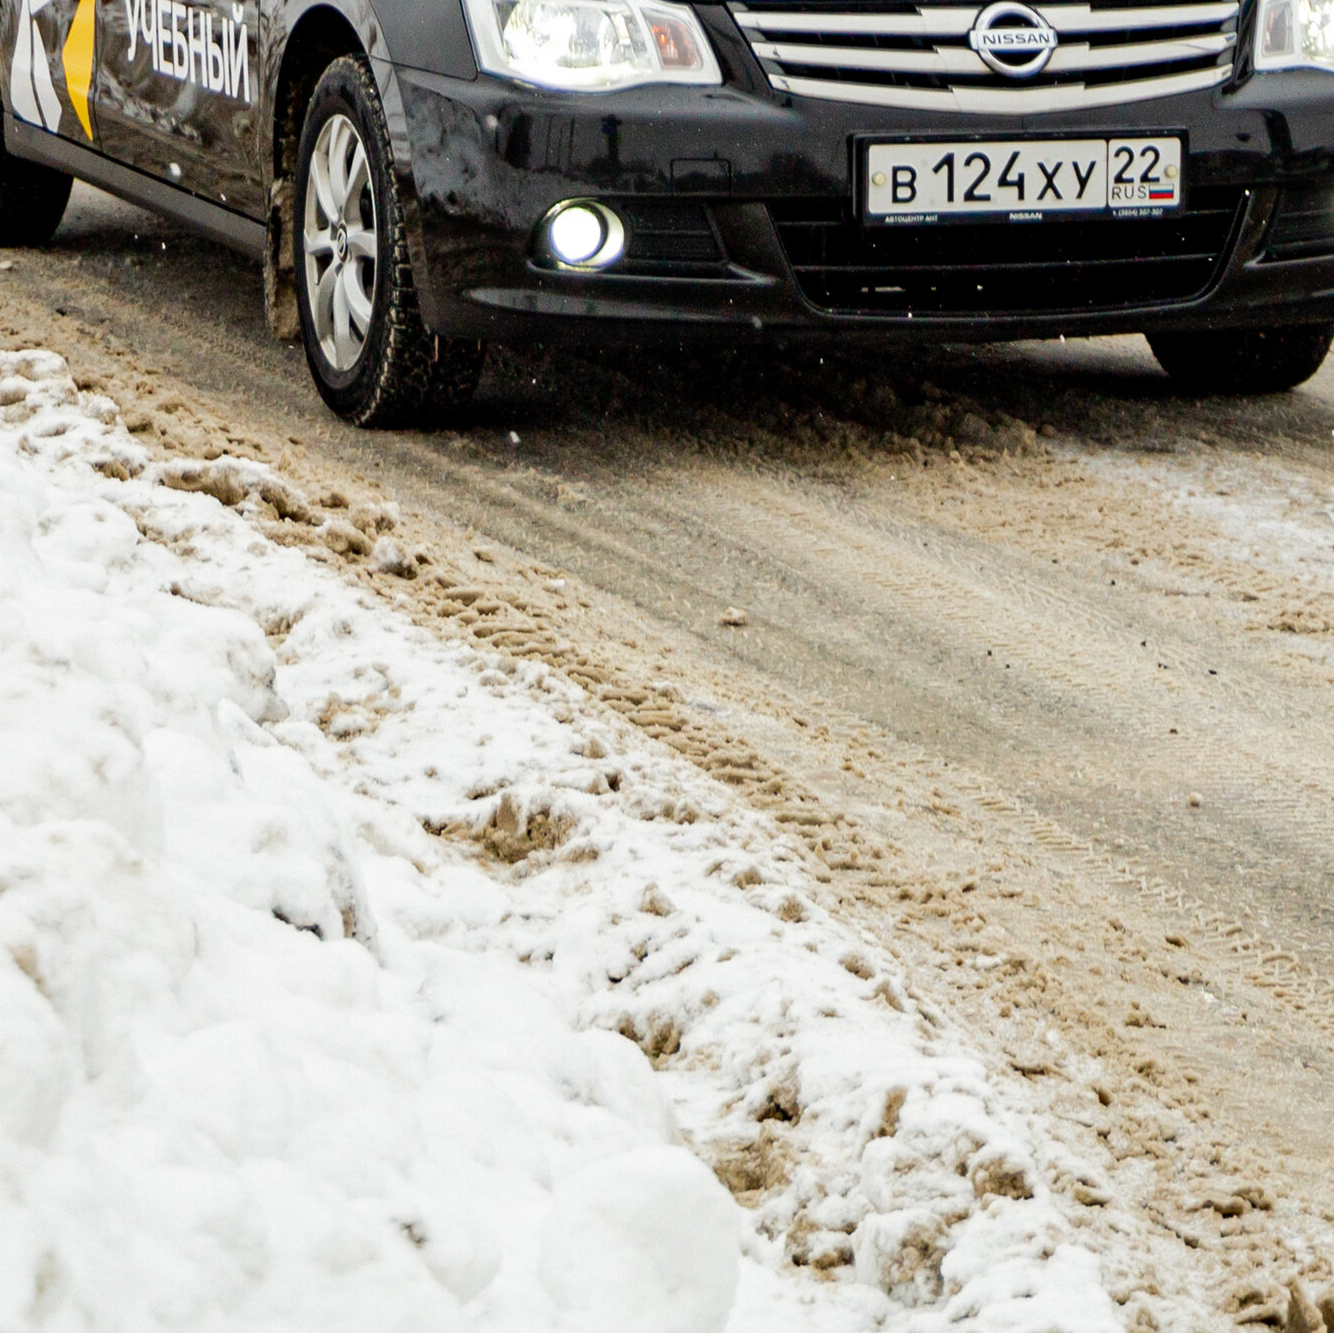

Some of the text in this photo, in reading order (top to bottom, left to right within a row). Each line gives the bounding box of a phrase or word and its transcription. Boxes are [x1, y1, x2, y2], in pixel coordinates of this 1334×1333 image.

[982, 33, 1052, 45] NISSAN
[1113, 145, 1160, 184] 22
[1112, 185, 1147, 200] RUS
[1009, 212, 1043, 220] NISSAN
